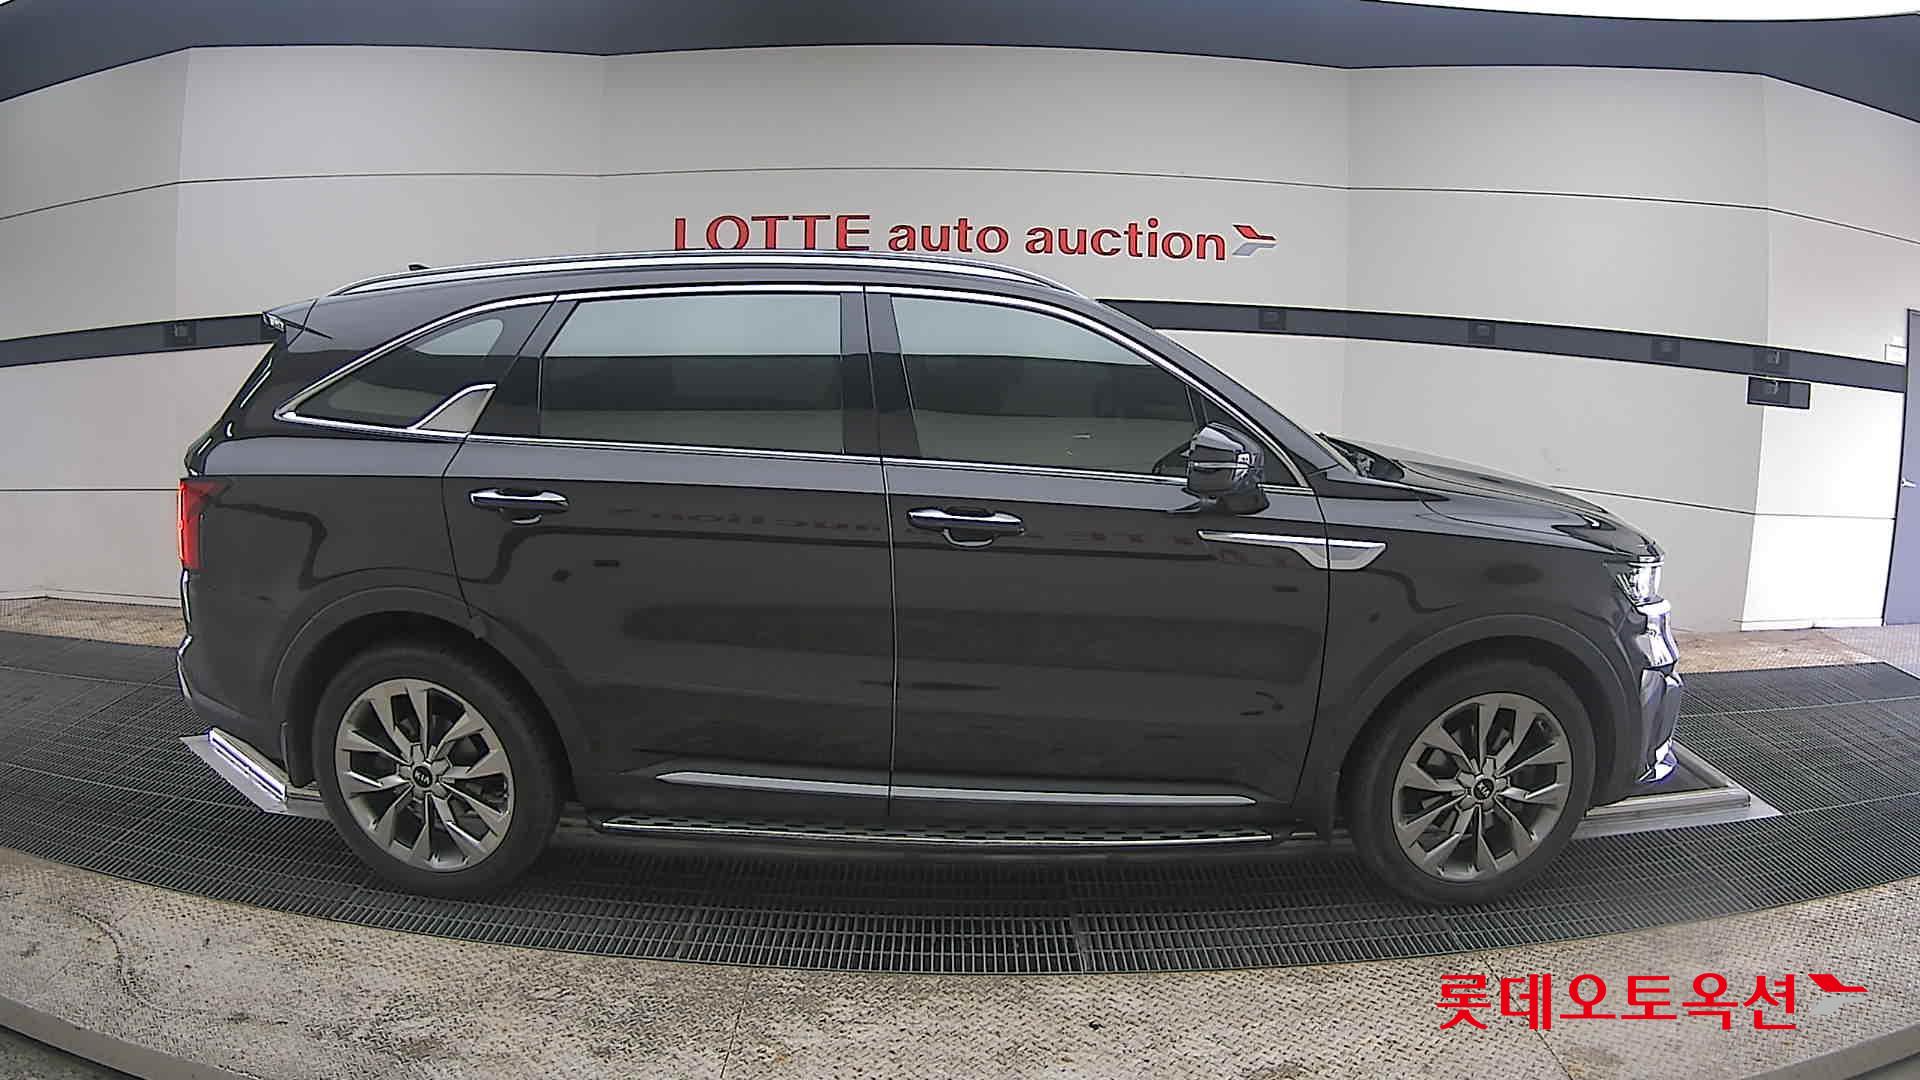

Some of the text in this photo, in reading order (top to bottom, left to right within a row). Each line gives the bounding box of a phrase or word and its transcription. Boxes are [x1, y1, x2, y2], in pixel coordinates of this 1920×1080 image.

[674, 215, 1226, 261] LOTTE auto auction
